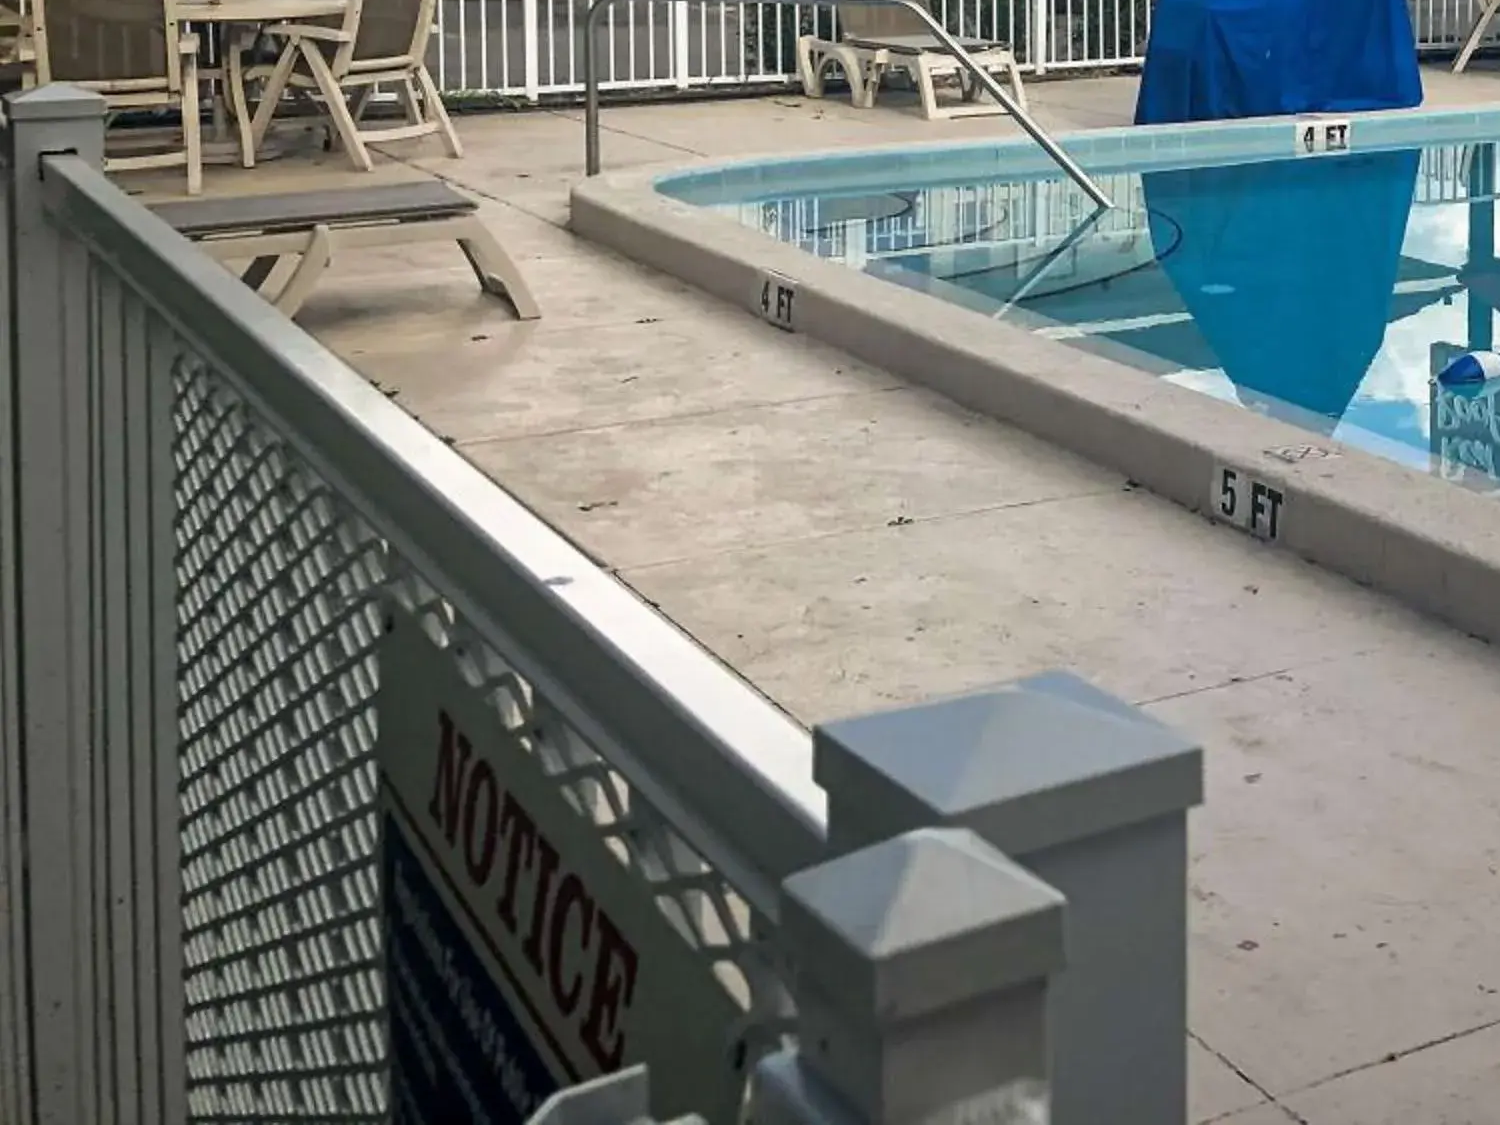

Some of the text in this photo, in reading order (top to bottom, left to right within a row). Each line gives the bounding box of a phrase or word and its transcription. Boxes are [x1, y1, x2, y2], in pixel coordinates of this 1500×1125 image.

[1303, 124, 1348, 142] 4 FT
[761, 280, 795, 324] 4 FT
[1221, 467, 1284, 540] 5 FT
[428, 709, 640, 1075] NOTICE
